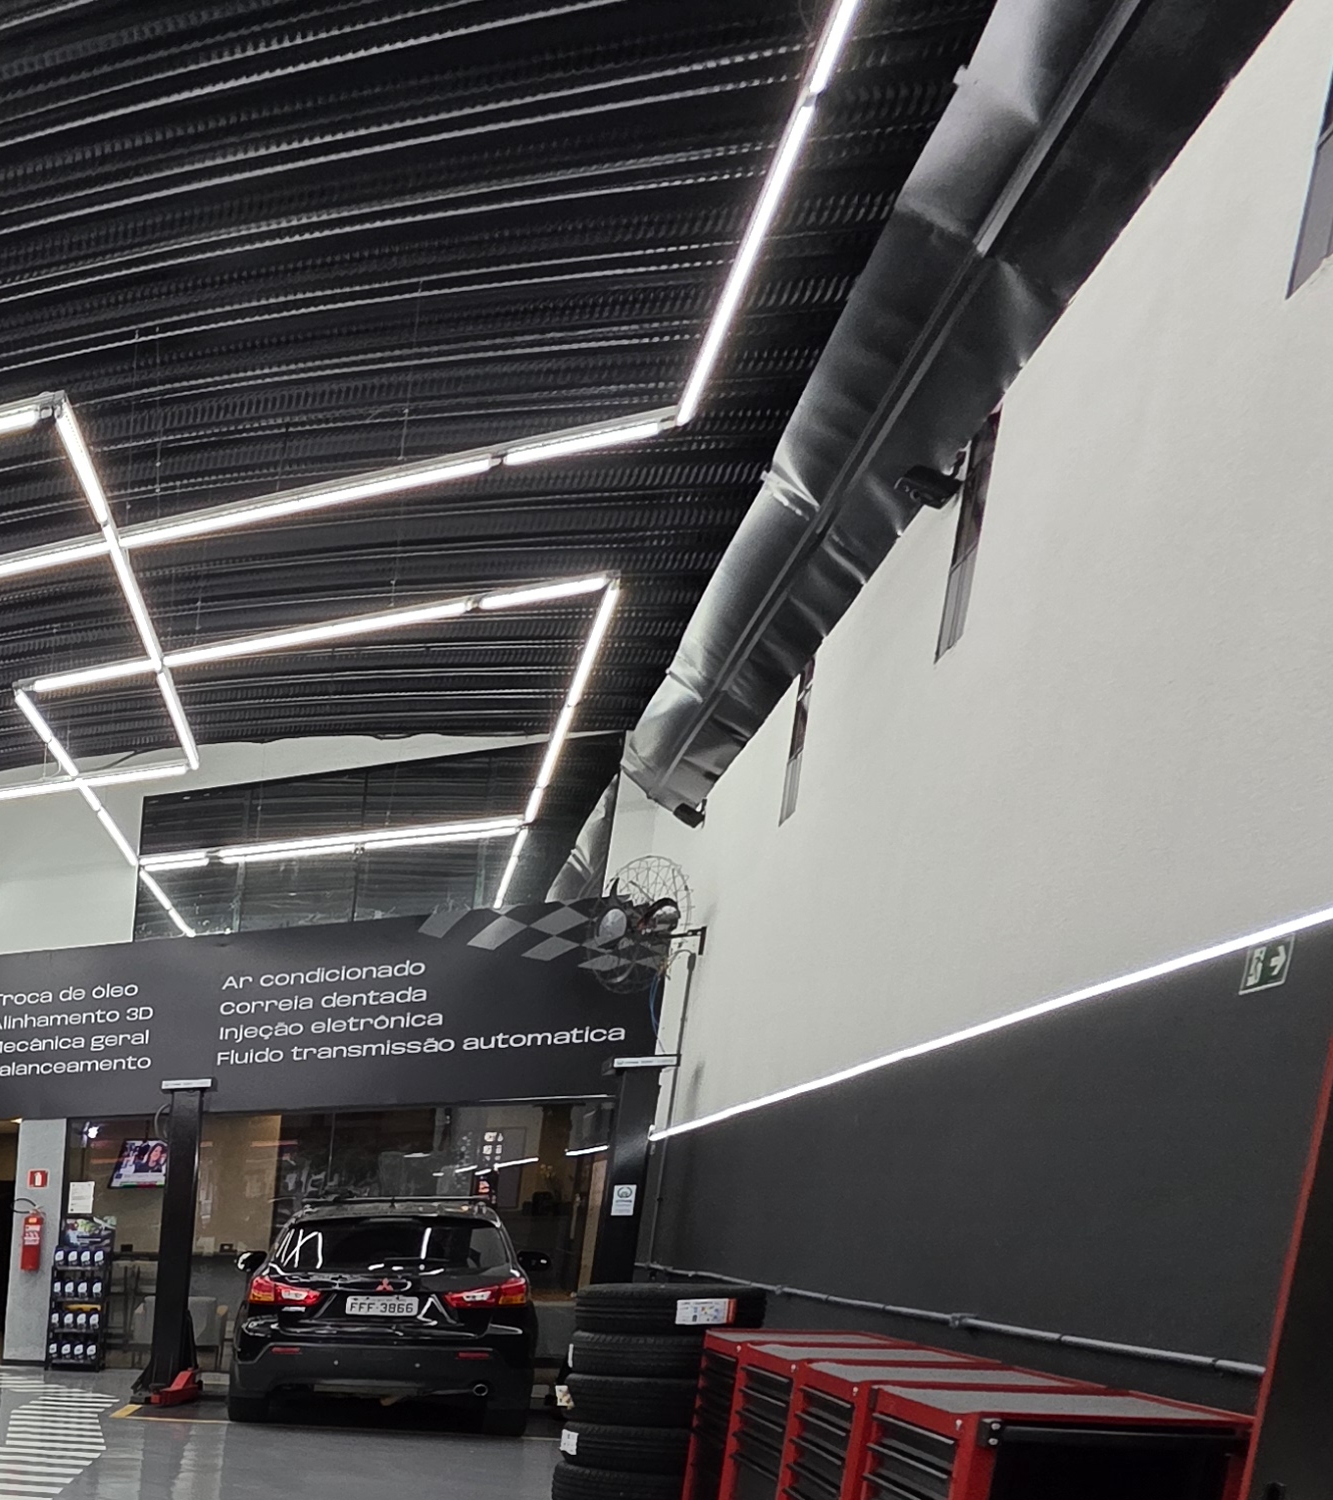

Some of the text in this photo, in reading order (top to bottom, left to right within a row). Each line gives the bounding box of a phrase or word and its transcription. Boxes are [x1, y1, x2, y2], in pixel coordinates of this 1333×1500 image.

[221, 959, 426, 991] Ar condicionado
[58, 985, 86, 1002] de
[91, 982, 139, 999] óleo
[320, 985, 428, 1008] dentada
[125, 1006, 154, 1021] 3D
[219, 1011, 444, 1044] Injeção eletrônica
[89, 1028, 150, 1052] geral
[216, 1025, 626, 1066] Fluido transmissão automatica
